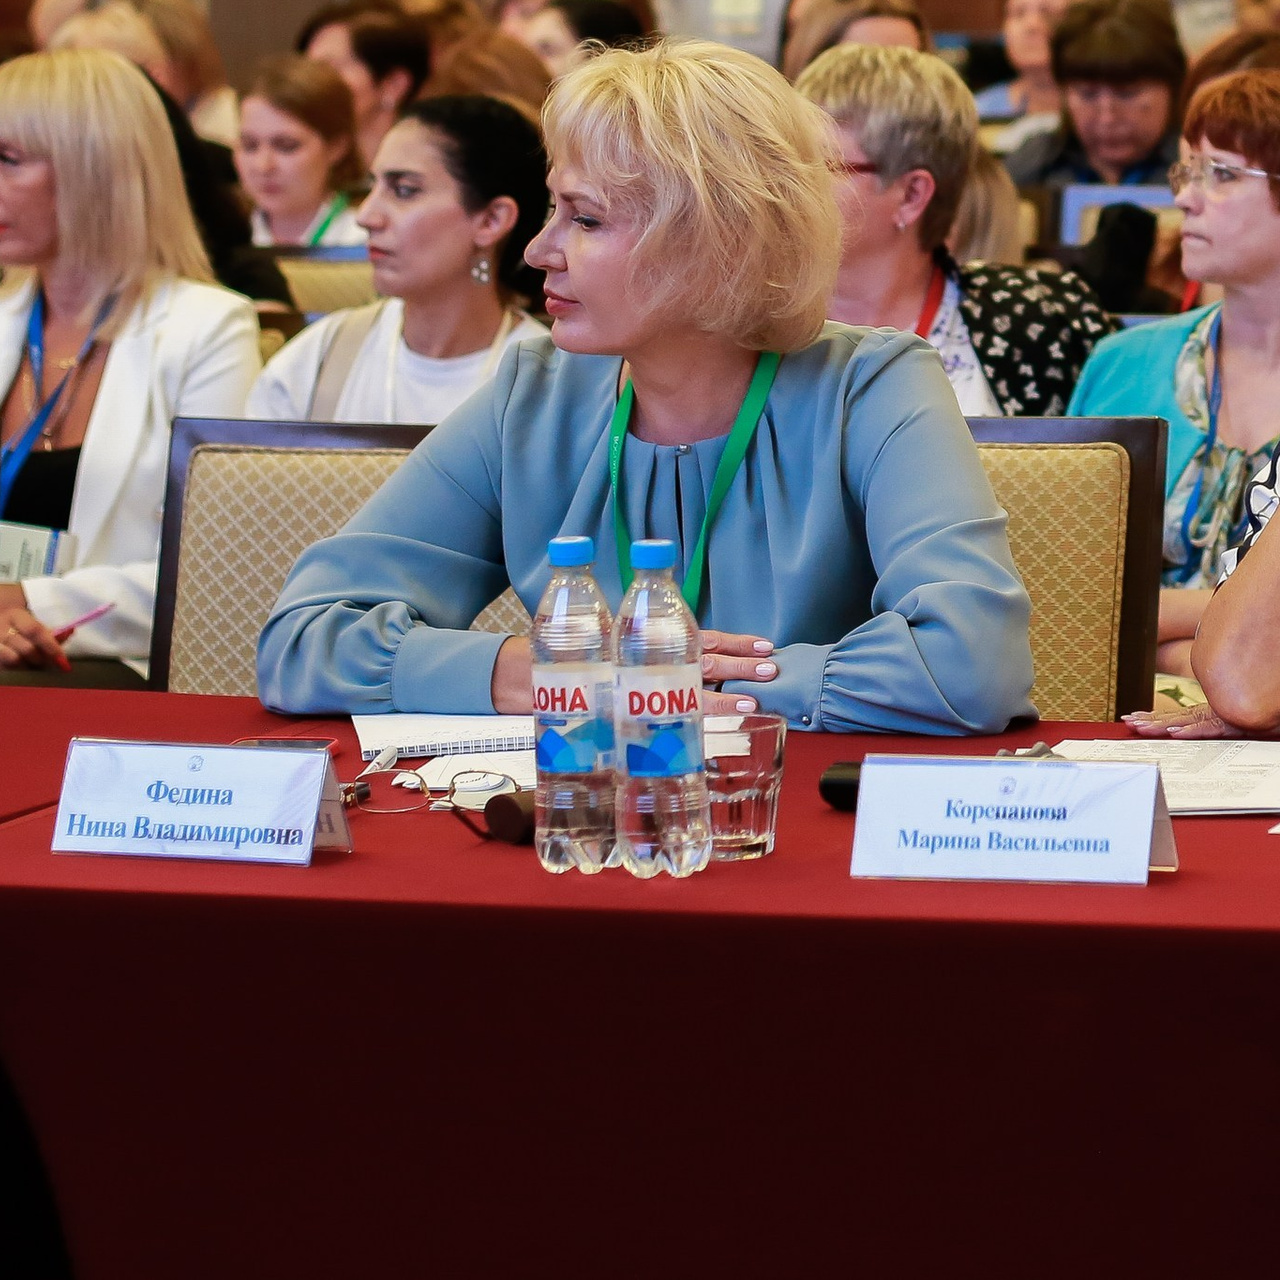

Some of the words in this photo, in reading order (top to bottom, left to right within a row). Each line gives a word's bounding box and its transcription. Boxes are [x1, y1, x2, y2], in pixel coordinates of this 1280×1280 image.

[628, 687, 698, 716] DONA
[146, 780, 233, 807] Федина
[945, 799, 1068, 823] Корепанова
[66, 813, 126, 838] Нина
[132, 816, 304, 849] Владимировна
[897, 829, 981, 854] Марина
[987, 831, 1110, 854] Васильевна
